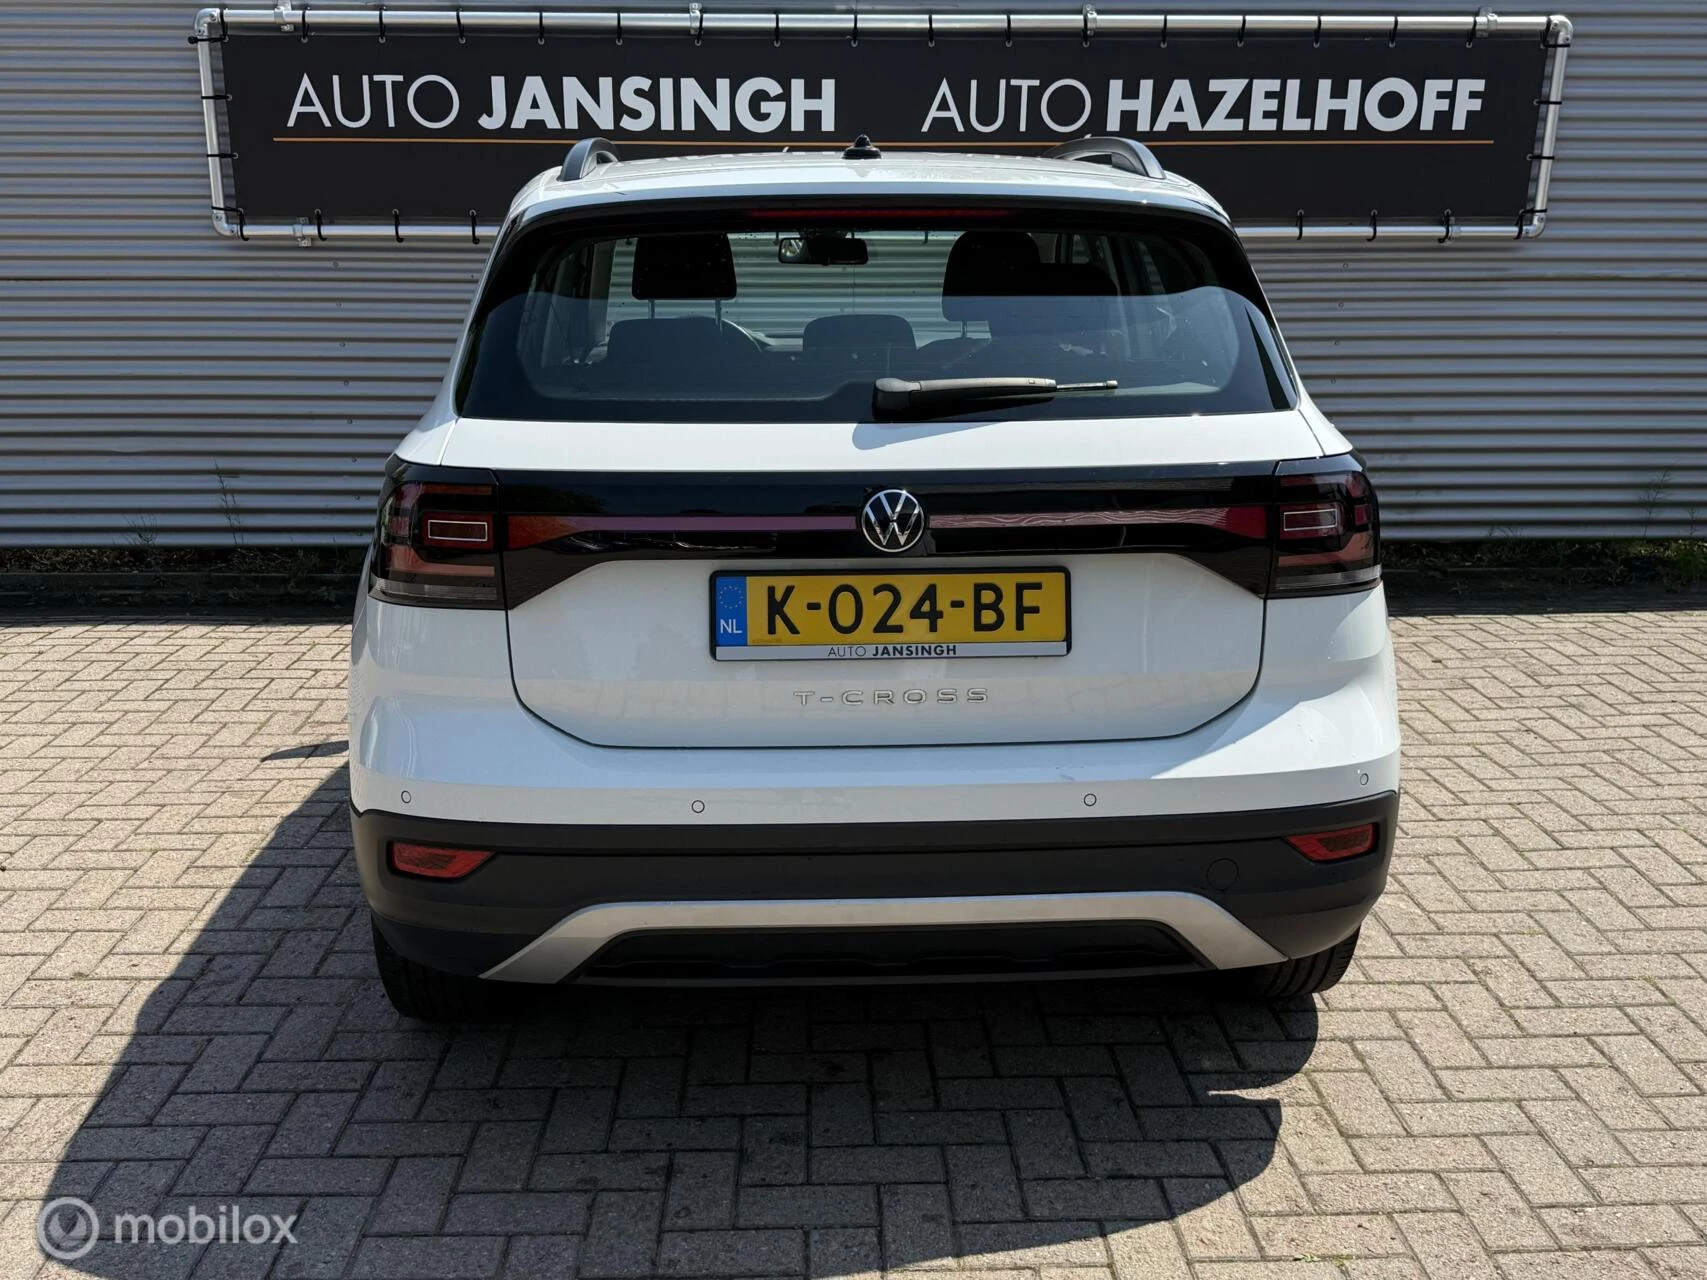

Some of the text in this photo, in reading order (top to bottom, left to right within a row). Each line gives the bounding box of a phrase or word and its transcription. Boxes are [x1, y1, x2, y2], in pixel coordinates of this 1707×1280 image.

[287, 72, 836, 133] AUTO JANSINGH
[921, 77, 1486, 133] AUTO HAZELHOFF
[766, 582, 1043, 635] K-024-BF
[719, 619, 743, 634] NL
[827, 644, 957, 657] AUTO JANSINGH
[793, 688, 989, 705] T-CROSS
